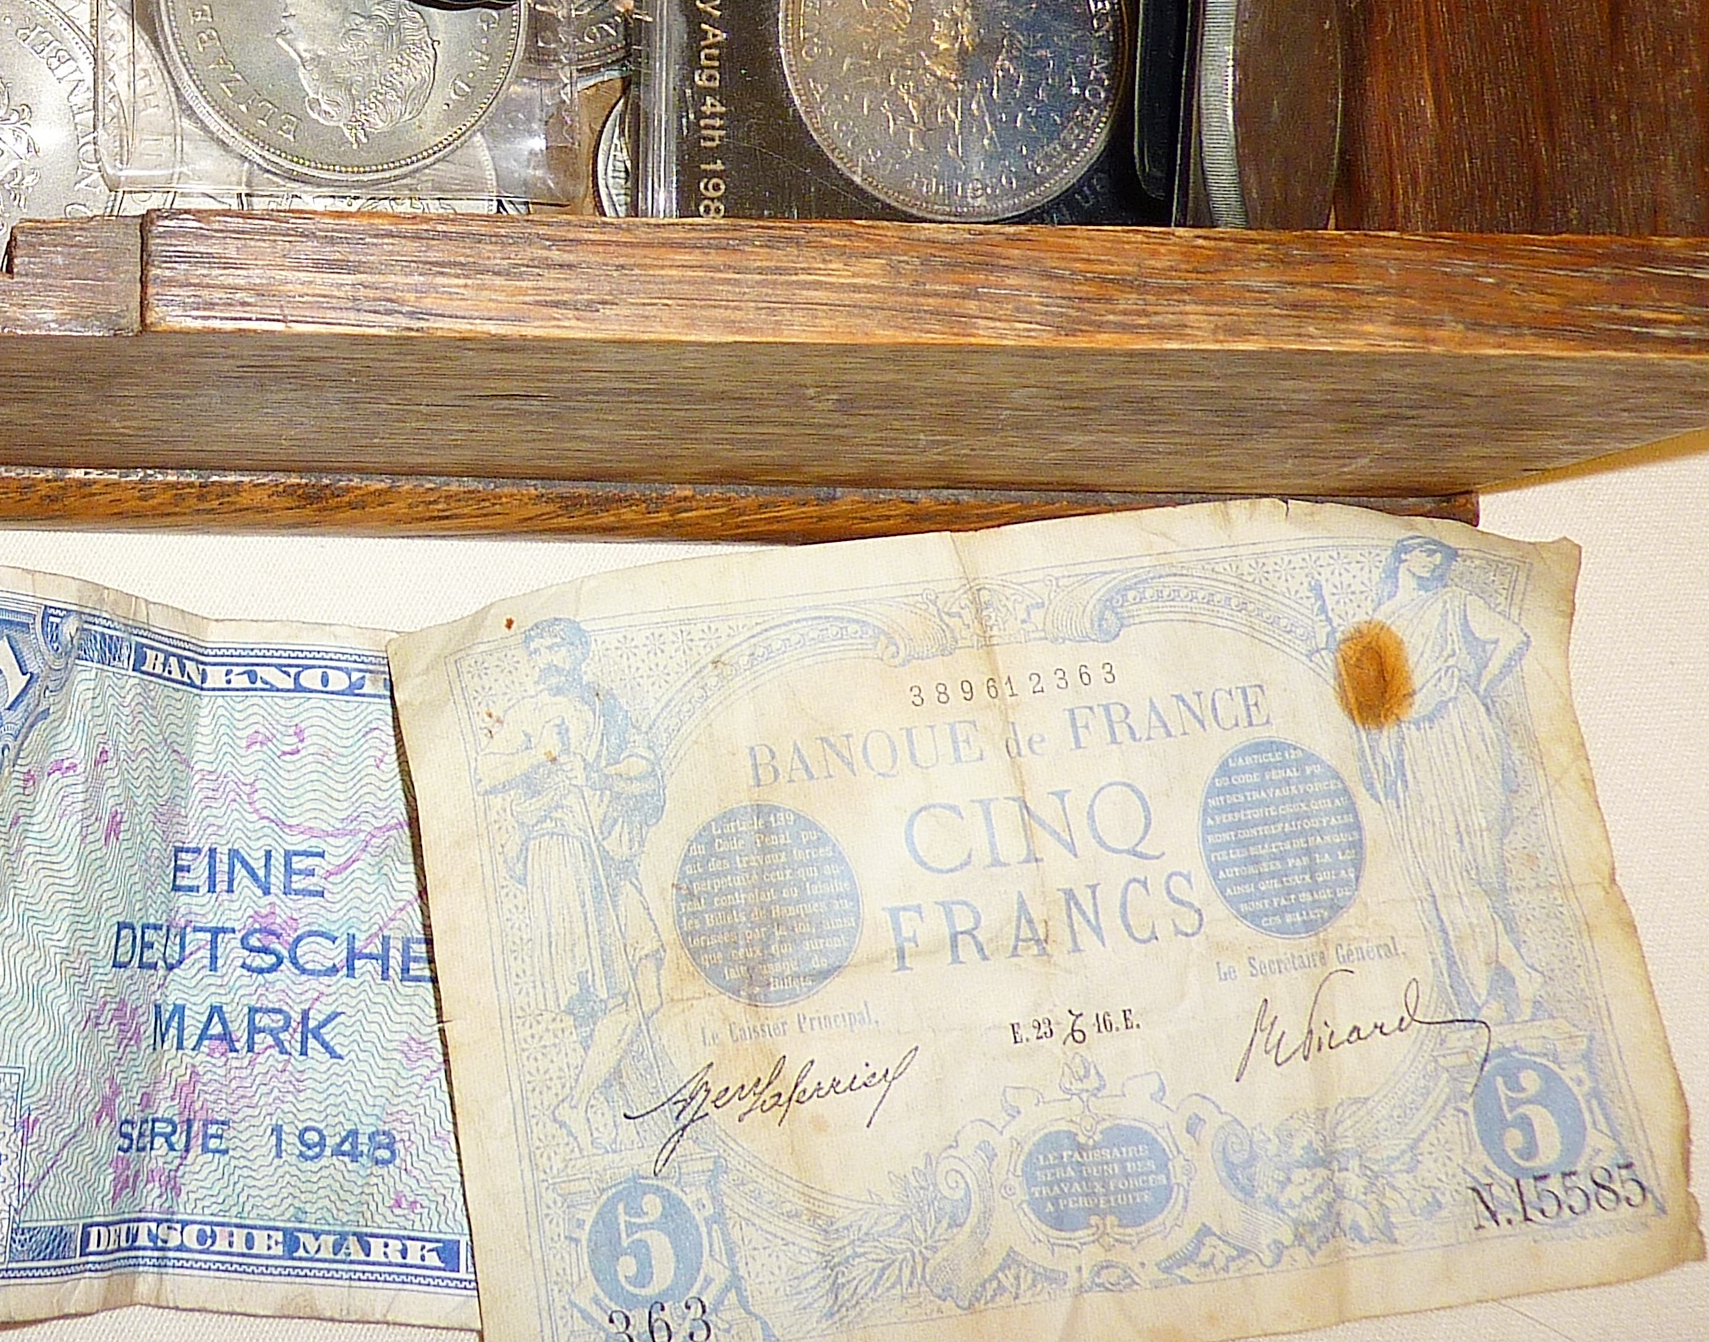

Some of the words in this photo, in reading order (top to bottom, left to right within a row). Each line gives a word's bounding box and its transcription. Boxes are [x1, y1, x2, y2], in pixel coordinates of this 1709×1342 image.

[693, 20, 727, 90] Aug
[697, 93, 726, 149] 4th
[908, 661, 1118, 709] 389612363
[747, 718, 983, 789] BANQUE
[1005, 722, 1047, 761] de
[1065, 683, 1275, 753] FRANCE
[903, 779, 1167, 875] CINQ
[170, 844, 325, 900] EINE
[883, 868, 1206, 974] FRANCS
[112, 921, 436, 984] DEUTSCHE
[1216, 961, 1238, 982] Le
[153, 1002, 345, 1061] MARK
[729, 1018, 789, 1044] Caissier
[117, 1114, 231, 1157] SERIE
[269, 1123, 398, 1167] 1948
[1502, 1070, 1570, 1174] 5
[90, 1221, 283, 1259] DEUTSCHE
[293, 1234, 446, 1266] MARK
[615, 1195, 682, 1299] 5
